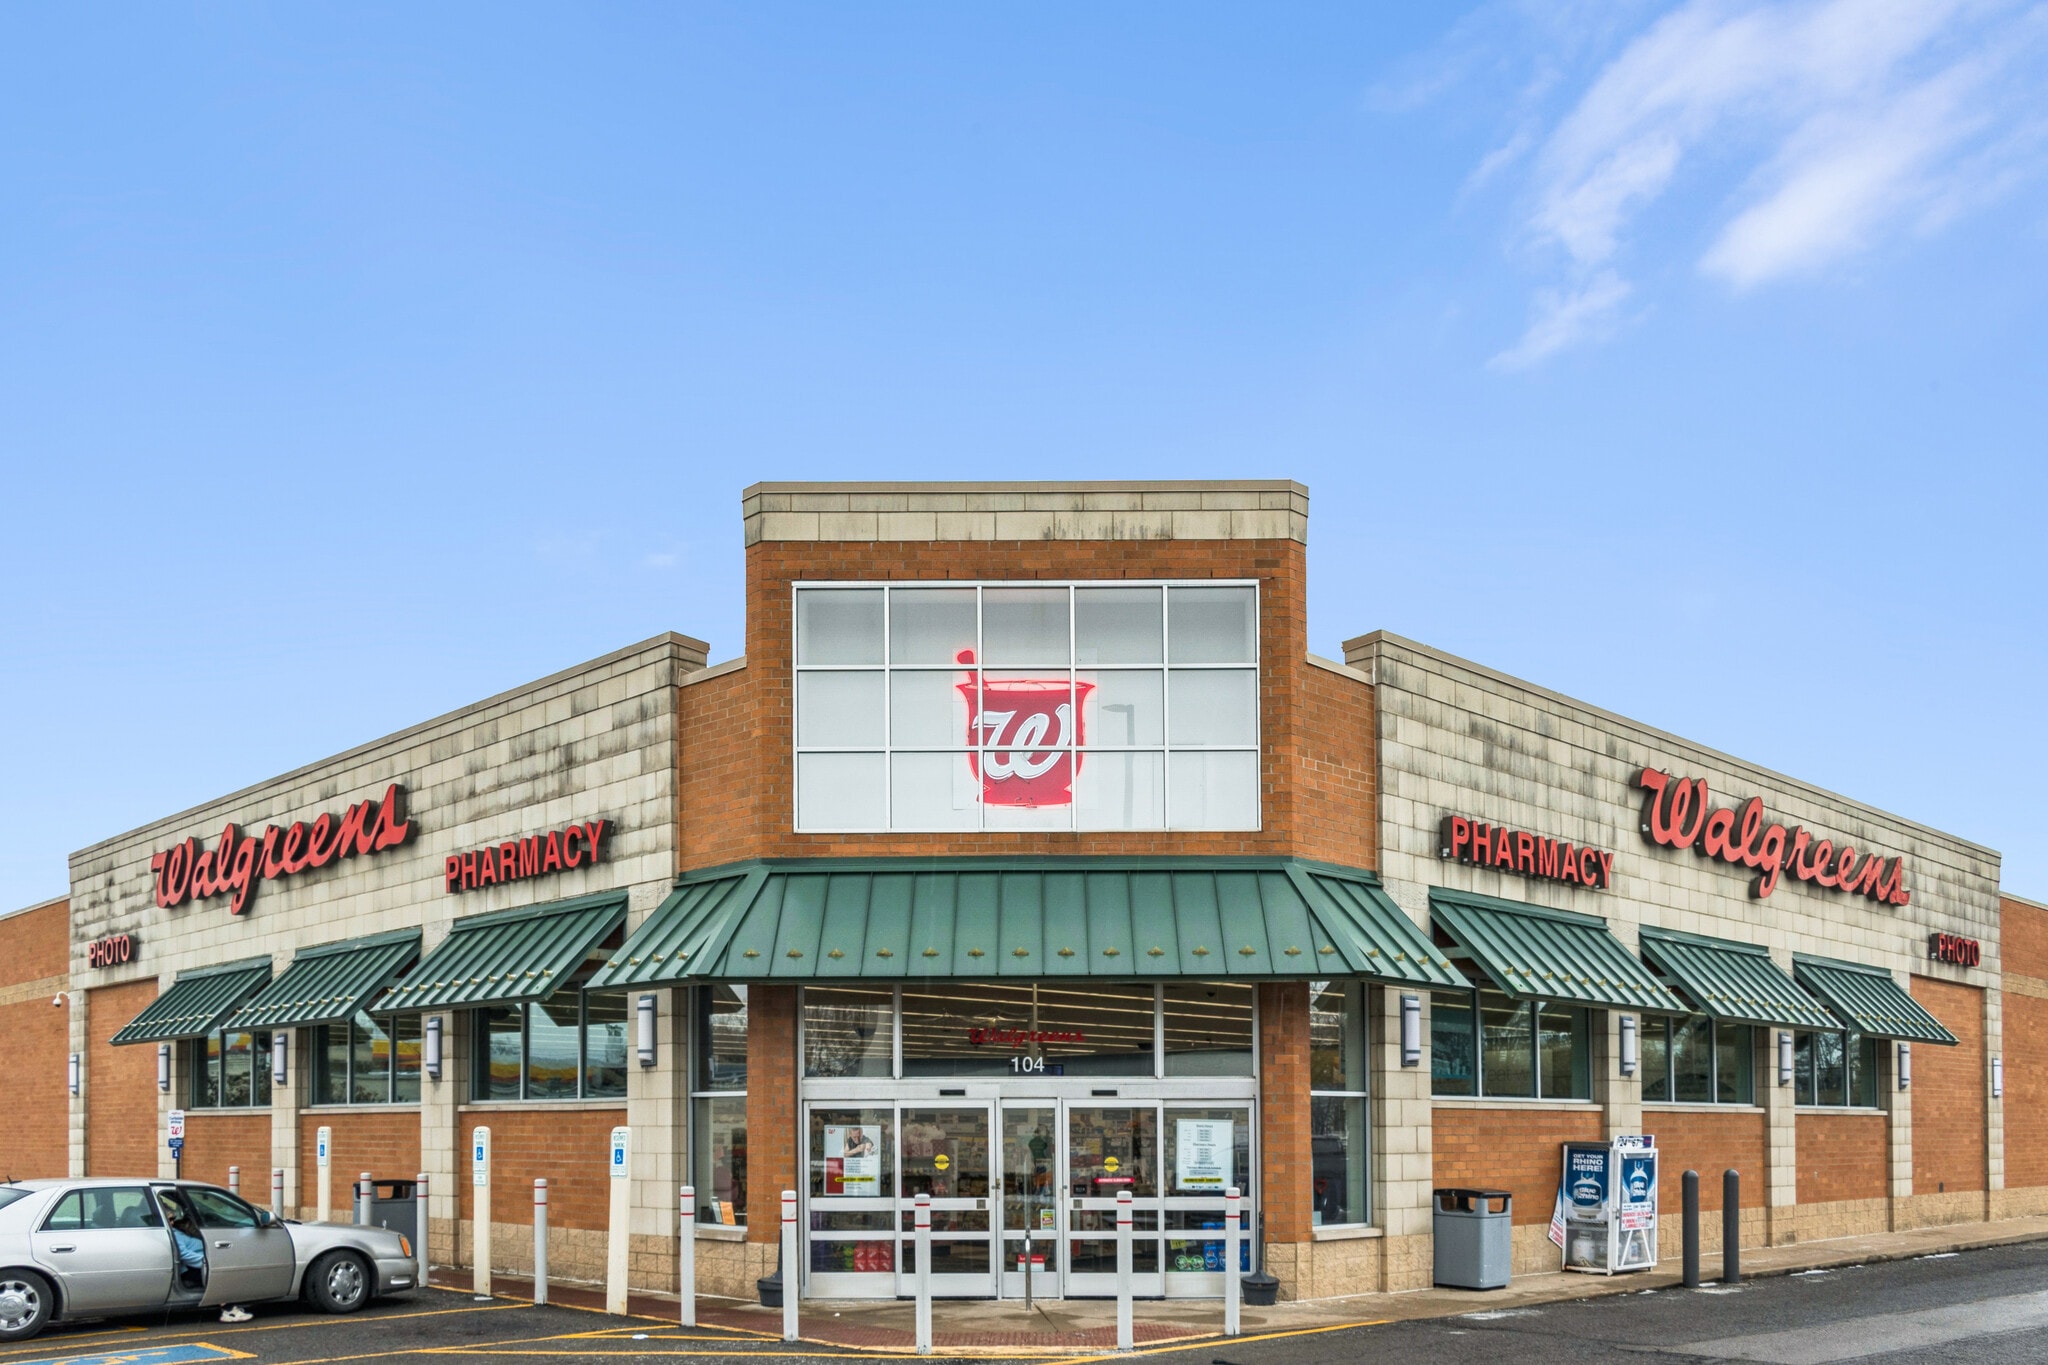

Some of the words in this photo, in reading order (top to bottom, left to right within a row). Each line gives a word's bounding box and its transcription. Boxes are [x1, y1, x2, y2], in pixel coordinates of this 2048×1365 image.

[150, 782, 410, 917] Walgreens
[445, 818, 606, 895] PHARMACY
[1451, 814, 1614, 890] PHARMACY
[1639, 766, 1912, 907] Walgreens
[88, 933, 130, 969] PHOTO
[1937, 931, 1981, 968] PHOTO
[966, 1026, 1087, 1050] Walgreens
[1010, 1055, 1045, 1073] 104
